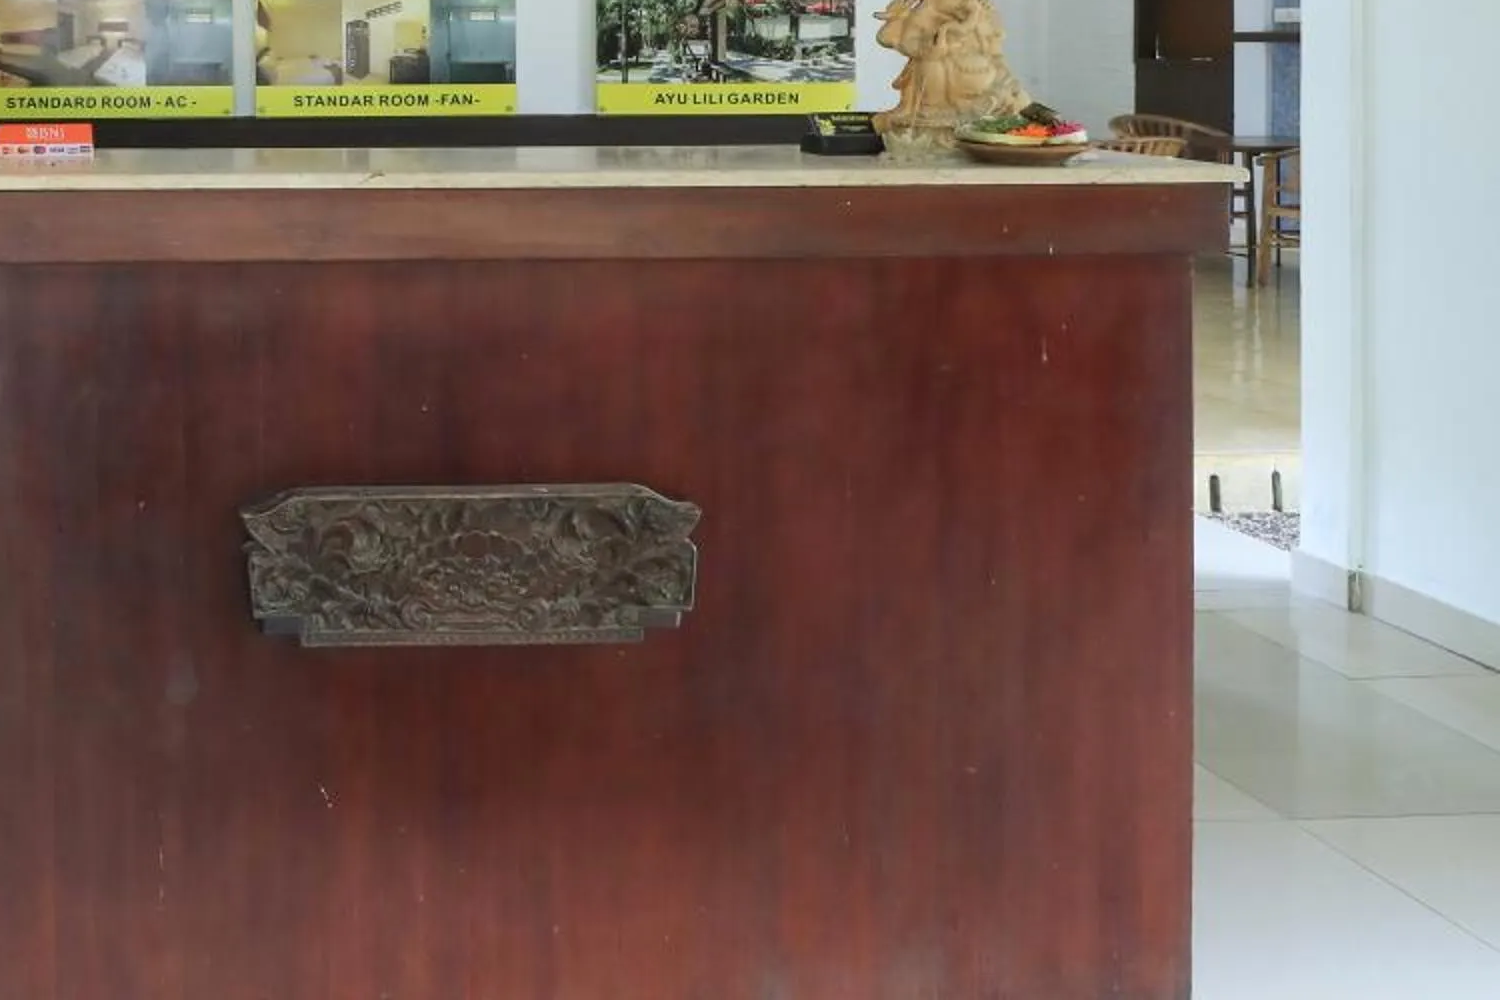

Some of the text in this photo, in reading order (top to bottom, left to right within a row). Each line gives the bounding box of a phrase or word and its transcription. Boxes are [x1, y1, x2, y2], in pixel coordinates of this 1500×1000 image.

[5, 96, 98, 109] STANDARD
[101, 95, 151, 109] ROOM
[293, 94, 374, 108] STANDAR
[379, 93, 430, 107] ROOM
[654, 92, 800, 106] AYU LILI GARDEN
